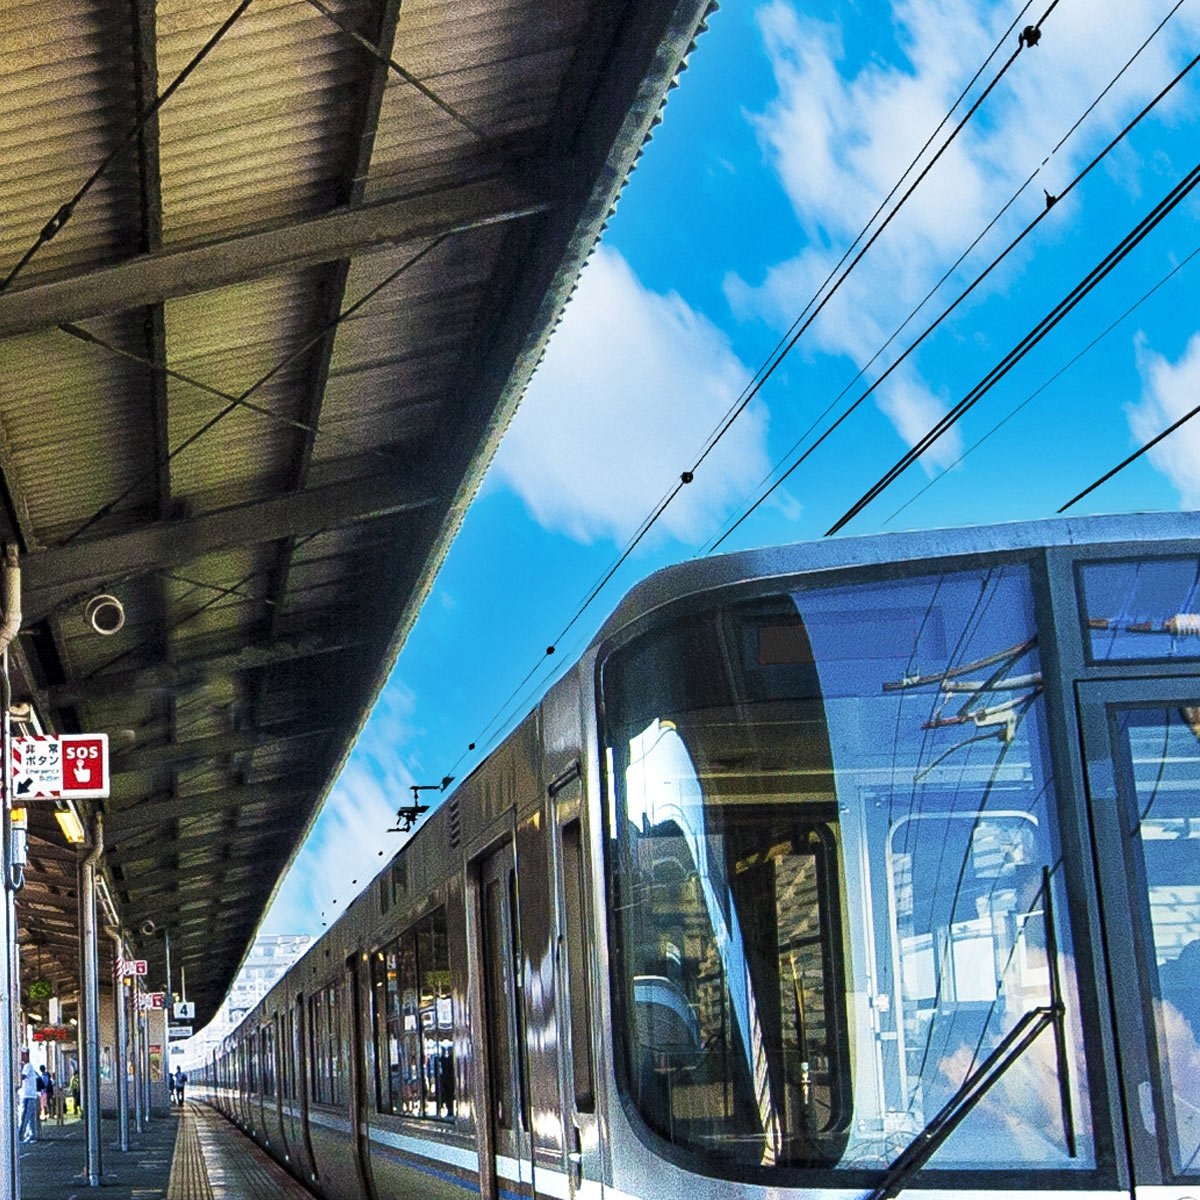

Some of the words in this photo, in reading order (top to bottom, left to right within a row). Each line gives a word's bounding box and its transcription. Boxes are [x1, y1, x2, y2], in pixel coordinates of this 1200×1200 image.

[66, 746, 98, 759] SOS
[26, 755, 59, 766] ボタン
[180, 1004, 188, 1016] 4
